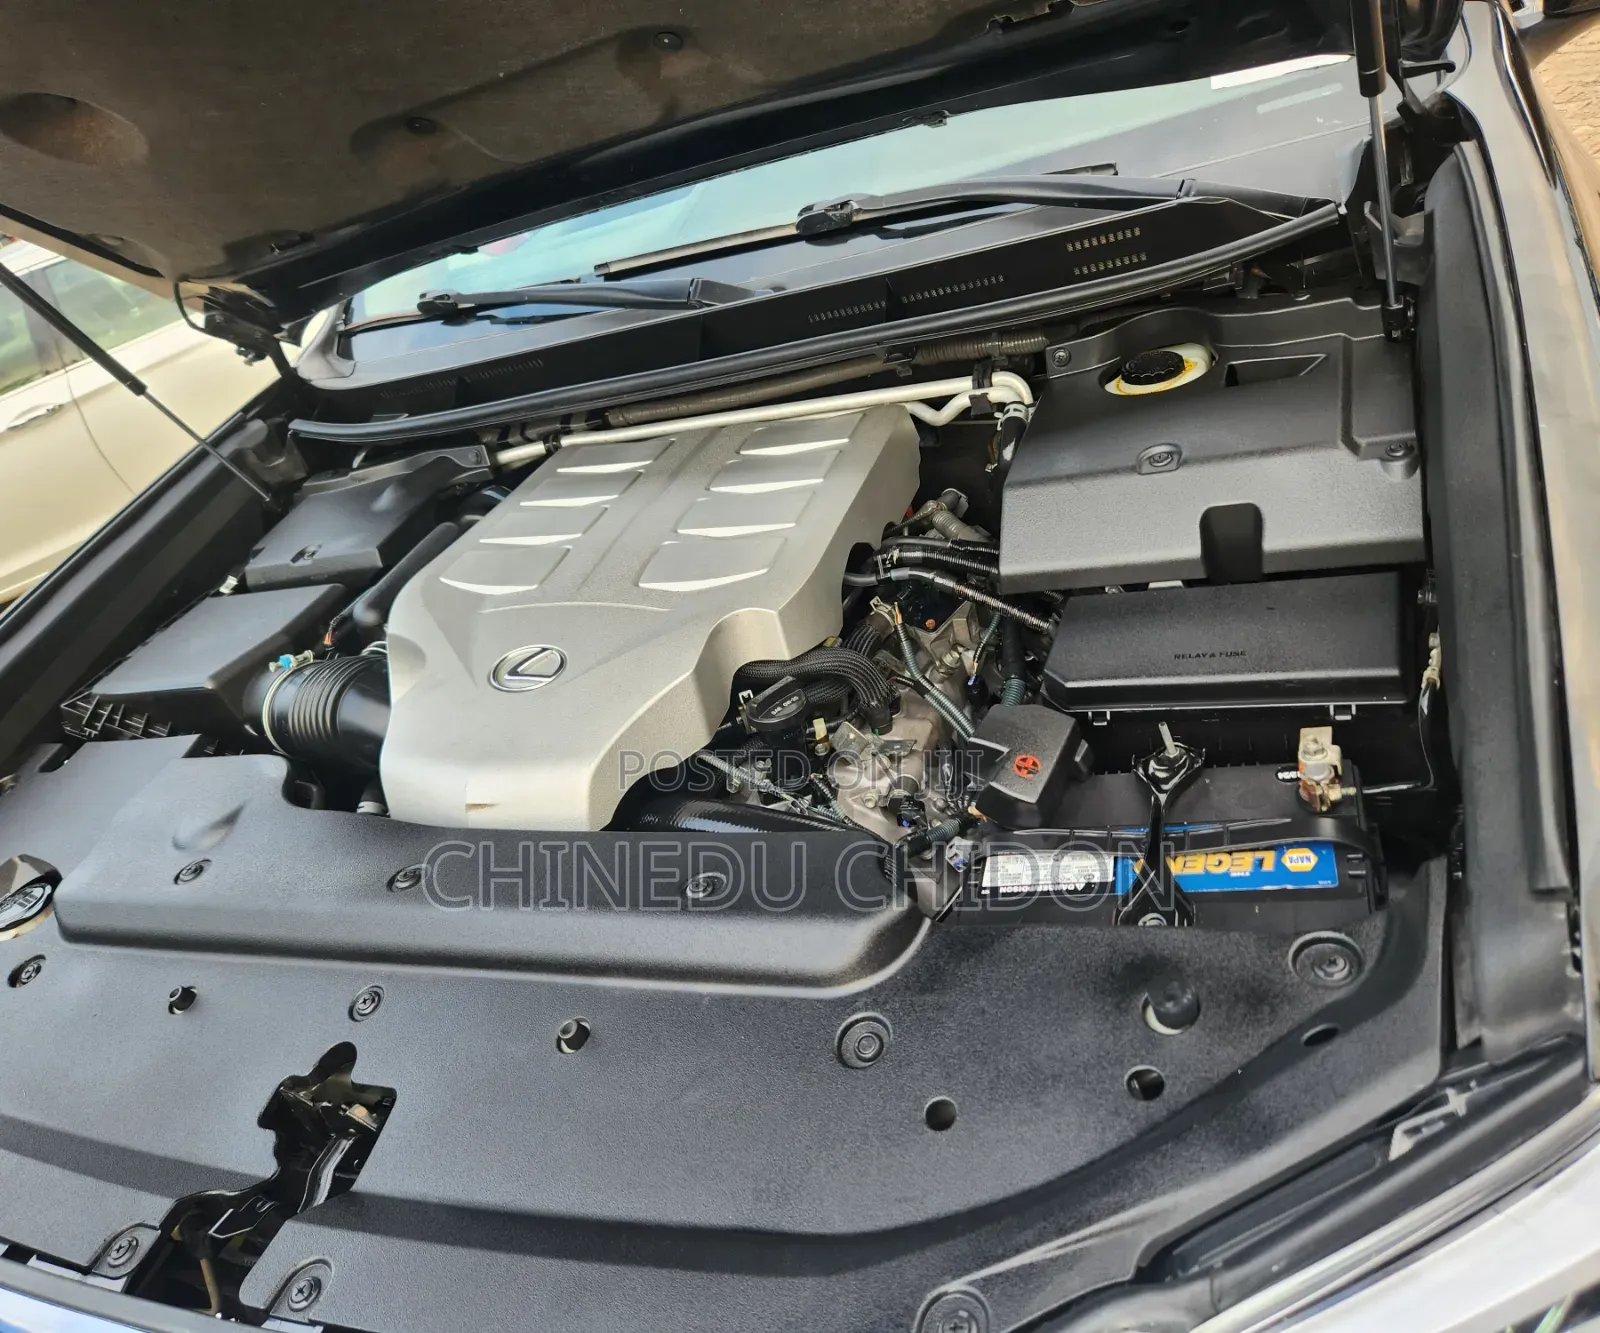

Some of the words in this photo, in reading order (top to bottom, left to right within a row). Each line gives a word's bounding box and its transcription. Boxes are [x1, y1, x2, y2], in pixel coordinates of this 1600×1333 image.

[1174, 652, 1208, 660] RELAY
[1219, 649, 1247, 658] FUSE
[1288, 854, 1312, 864] NAPA
